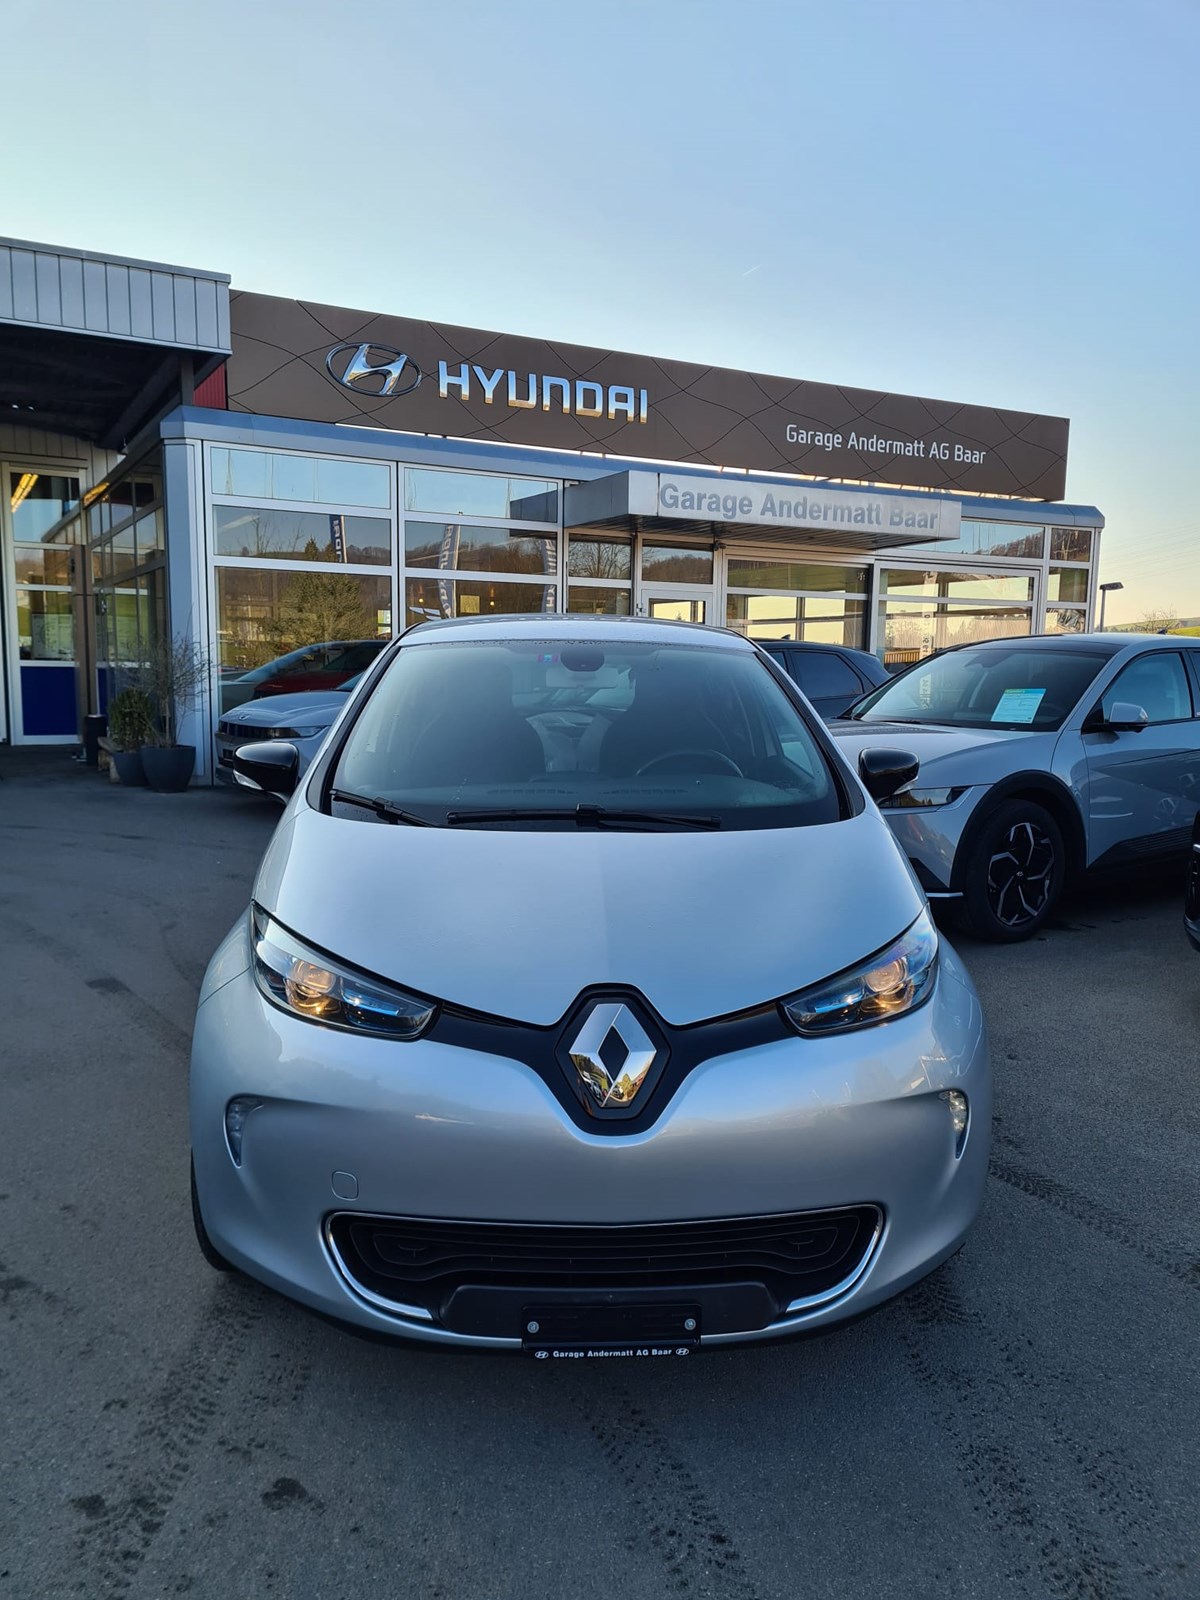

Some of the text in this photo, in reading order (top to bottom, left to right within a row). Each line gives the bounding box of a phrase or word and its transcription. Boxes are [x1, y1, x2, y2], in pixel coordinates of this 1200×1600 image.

[437, 360, 648, 423] HYUNDAI
[786, 424, 986, 464] Garage Andermatt AG Baar
[660, 483, 938, 530] Garage Andermatt Baar
[552, 1350, 585, 1358] Garage
[587, 1349, 634, 1357] Andermatt
